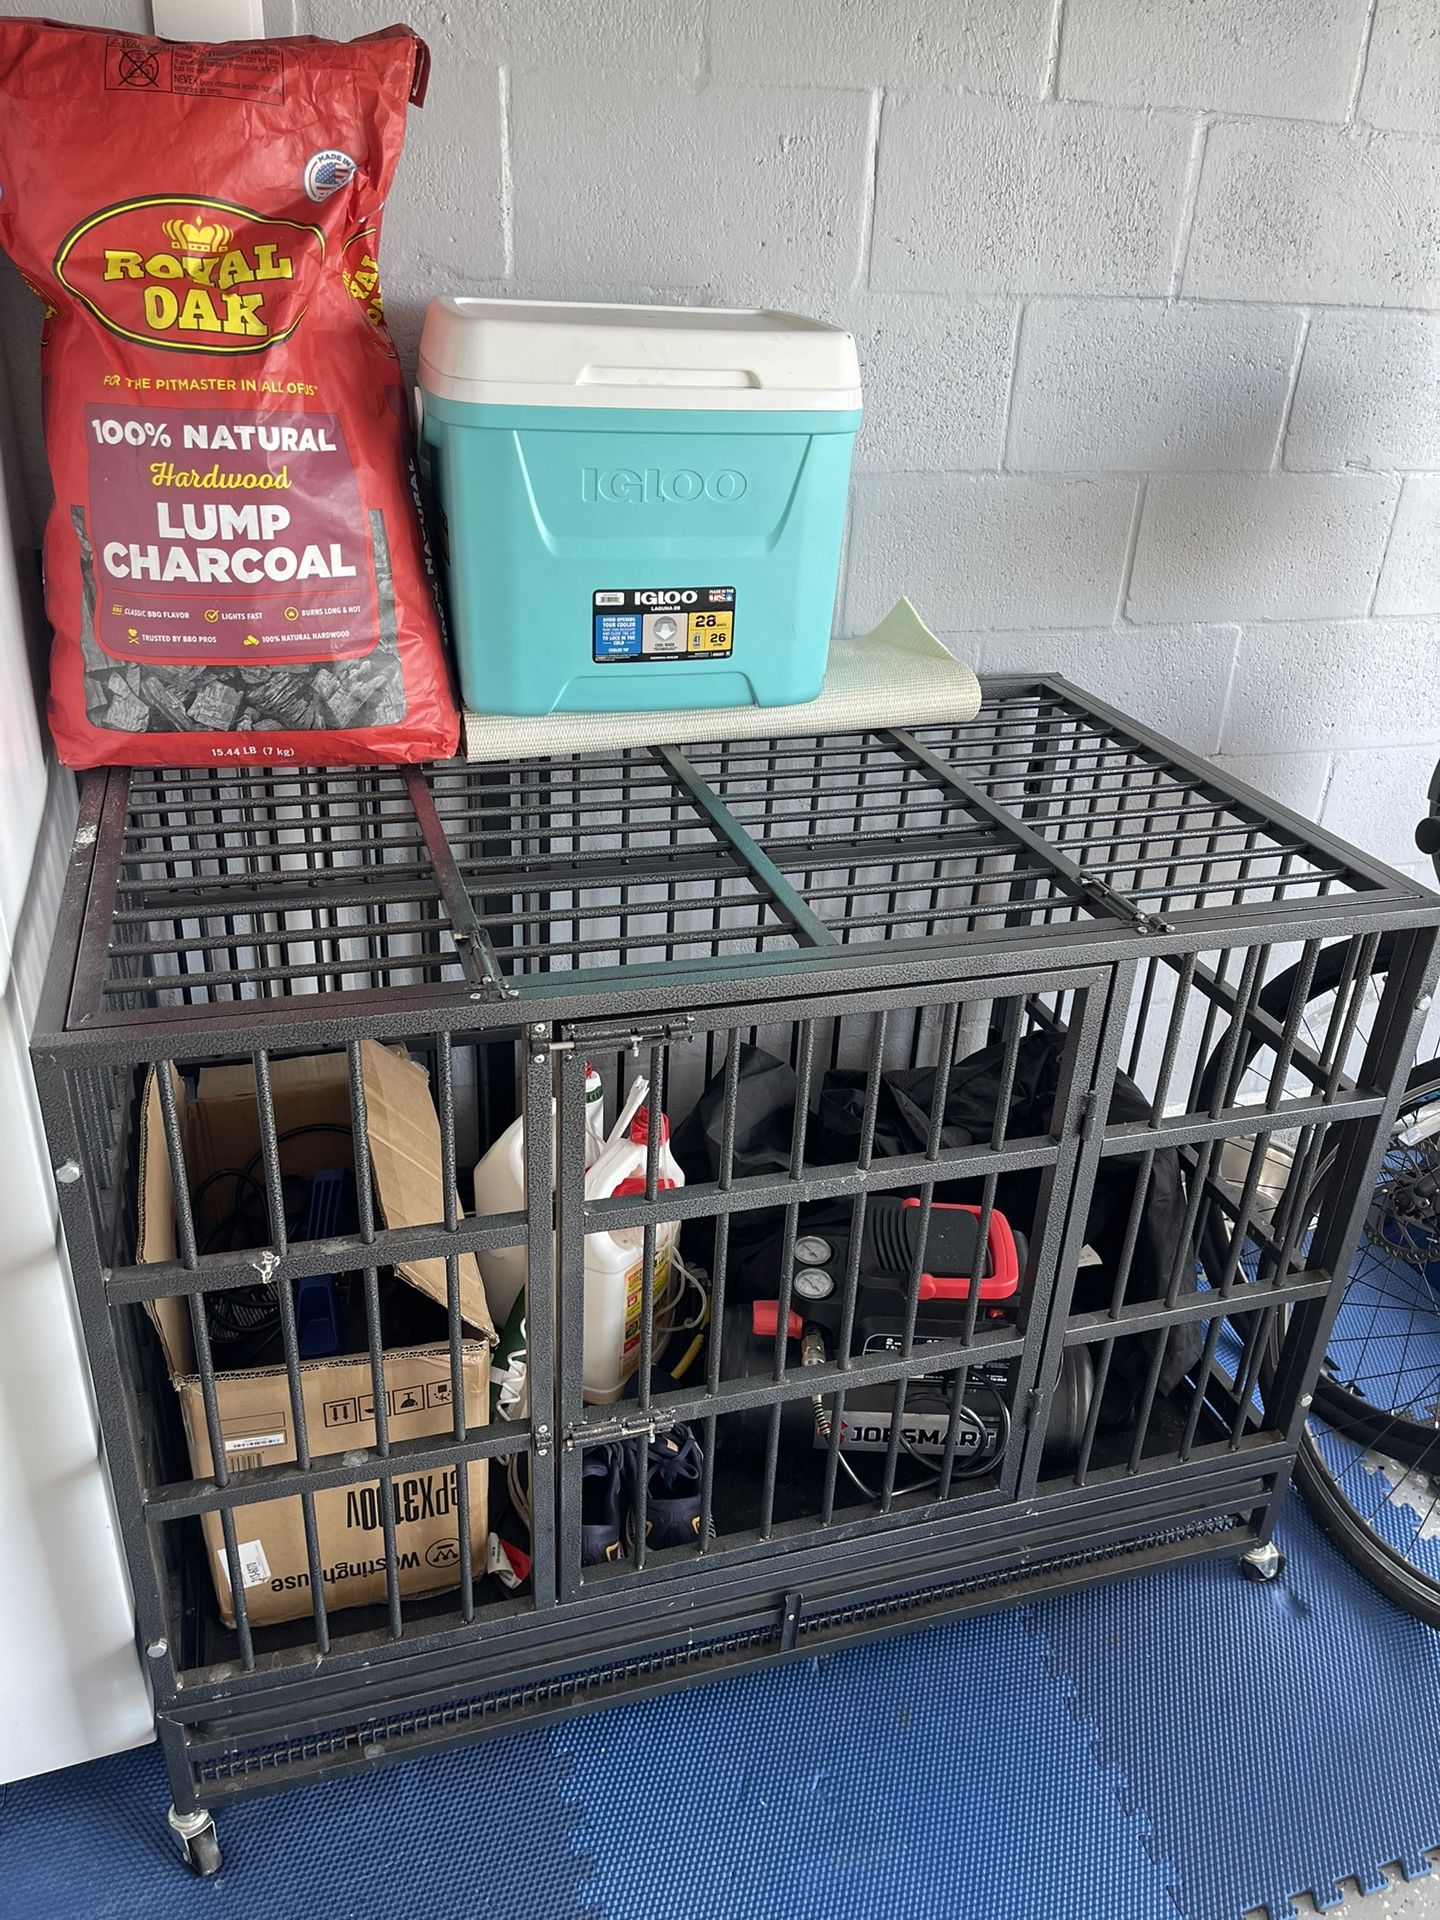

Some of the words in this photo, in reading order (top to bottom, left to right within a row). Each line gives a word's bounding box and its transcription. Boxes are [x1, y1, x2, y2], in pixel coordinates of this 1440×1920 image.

[318, 153, 341, 163] MADE
[103, 244, 293, 289] ROYAL
[144, 285, 269, 338] OAK
[103, 374, 121, 386] FOR
[125, 377, 151, 390] THE
[156, 378, 236, 391] PITMASTER
[241, 379, 257, 392] IN
[261, 380, 284, 393] ALL
[91, 418, 172, 449] 100%
[183, 424, 337, 452] NATURAL
[149, 461, 293, 490] Hardwood
[582, 467, 748, 503] IGLOO
[156, 501, 292, 541] LUMP
[103, 541, 357, 585] CHARCOAL
[634, 590, 698, 606] IGLOO
[124, 607, 146, 618] CLASSIC
[147, 609, 162, 619] BBQ
[163, 610, 191, 620] FLAVOR
[221, 612, 246, 621] LIGHTS
[247, 611, 264, 621] FAST
[301, 607, 323, 617] BURNS
[324, 606, 341, 616] LONG
[348, 605, 361, 614] HOT
[695, 614, 716, 628] 28
[141, 633, 171, 643] TRUSTED
[171, 634, 181, 643] BY
[182, 634, 198, 644] BBQ
[199, 635, 217, 644] PROS
[261, 634, 280, 644] 100%
[281, 632, 312, 642] NATURAL
[312, 630, 351, 641] HARDWOOD
[710, 632, 726, 643] 26
[211, 747, 241, 757] 15.44
[242, 745, 257, 755] LB
[262, 746, 273, 756] (7
[276, 746, 295, 757] kg)
[270, 1551, 421, 1593] Wstinghuse
